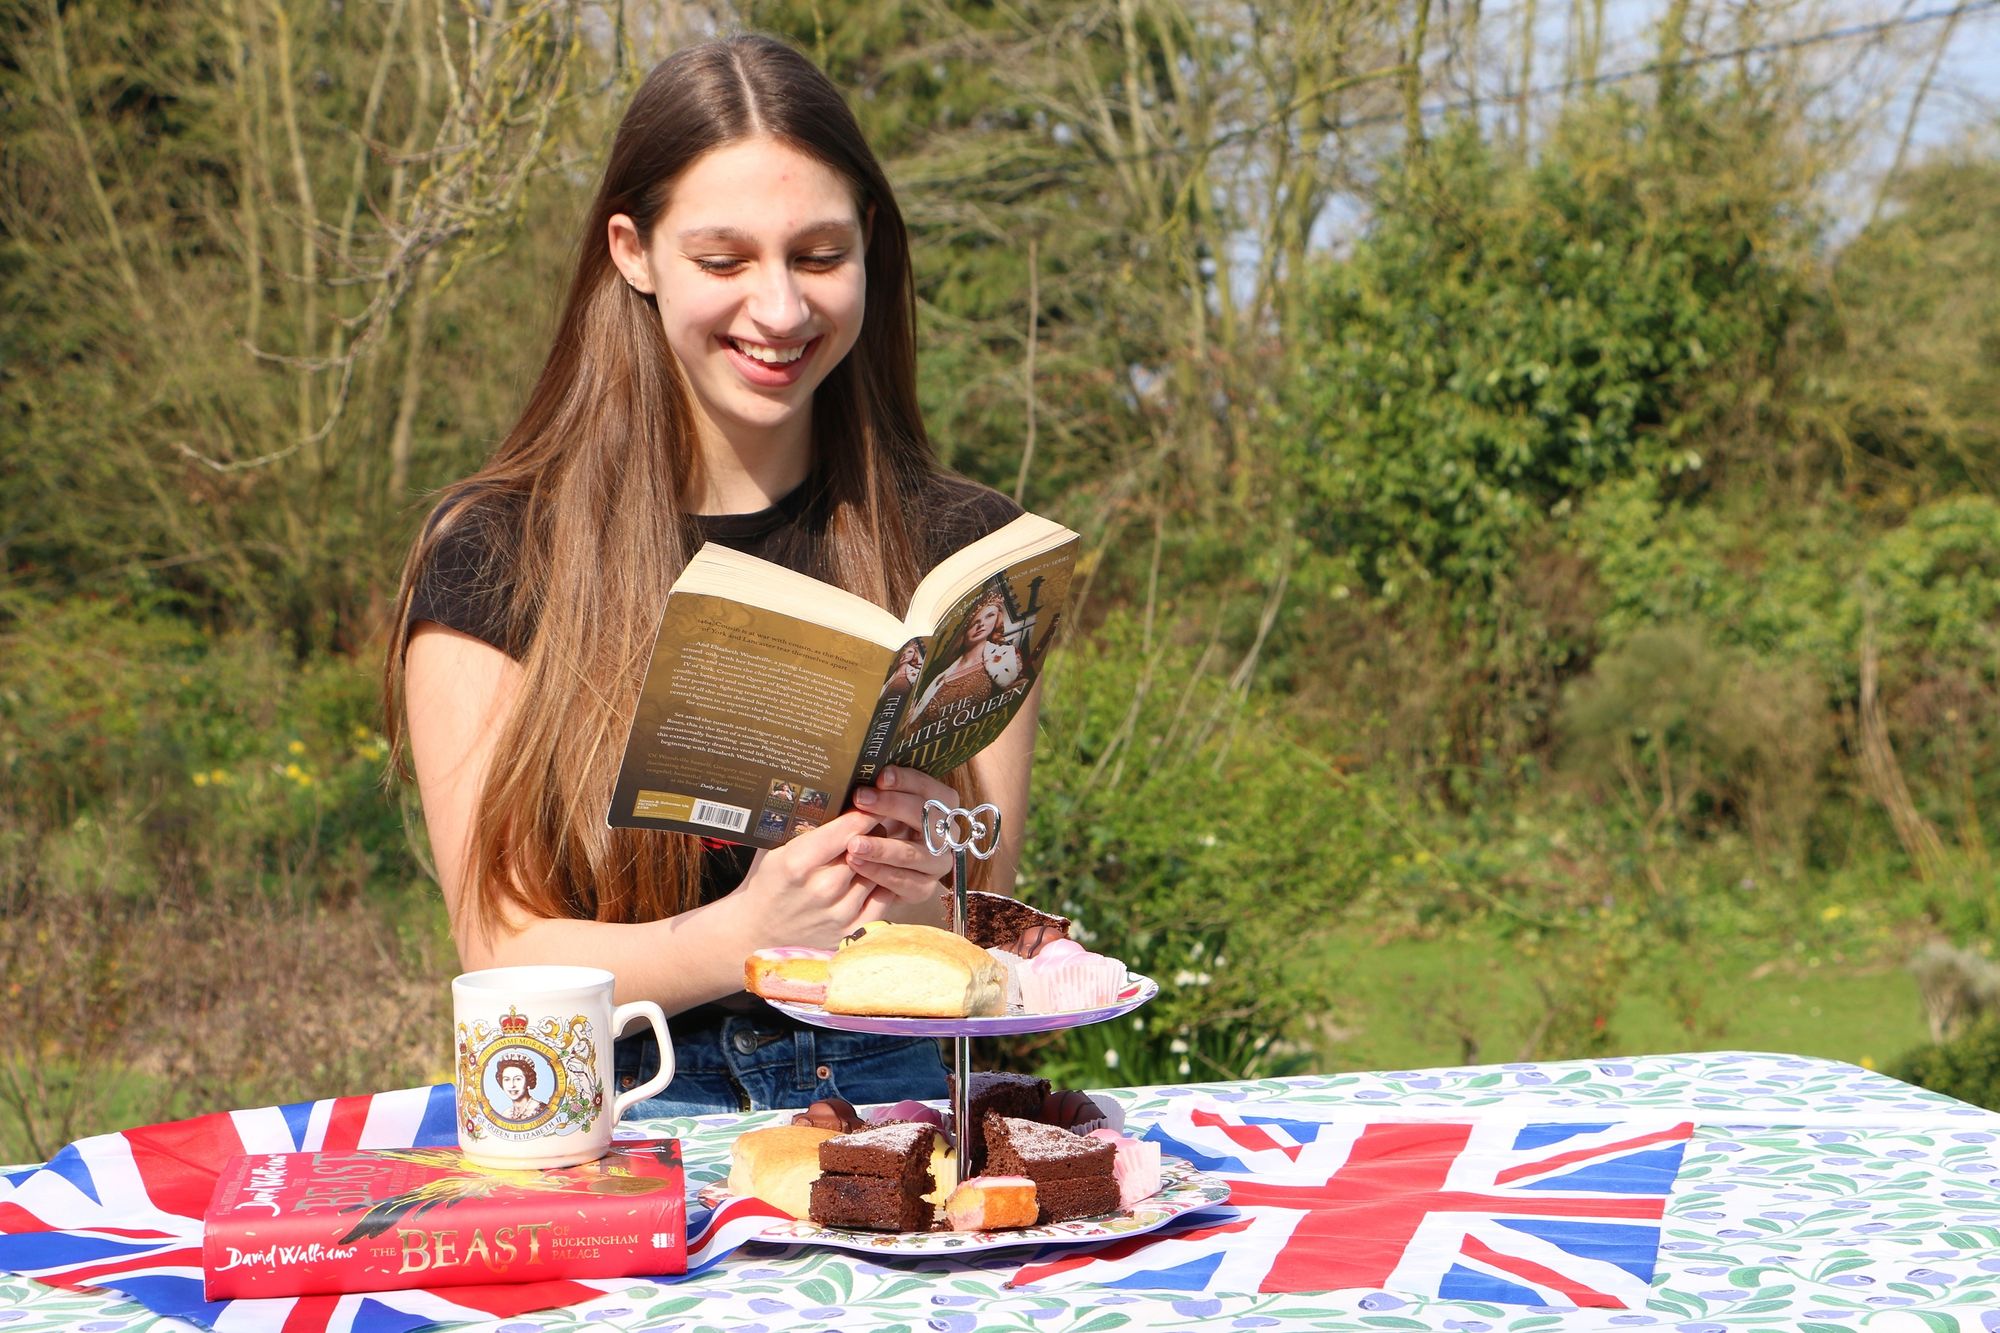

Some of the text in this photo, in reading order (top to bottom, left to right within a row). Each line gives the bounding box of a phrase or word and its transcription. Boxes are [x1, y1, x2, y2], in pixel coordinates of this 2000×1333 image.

[881, 695, 900, 718] THE
[940, 695, 974, 718] THE
[952, 682, 1029, 728] QUEEN
[865, 721, 891, 758] WHITE
[491, 1038, 551, 1054] COMMEMORATE
[476, 1116, 486, 1126] OF
[486, 1123, 510, 1139] QUEEN
[514, 1120, 555, 1140] ELIZABETH
[290, 1153, 392, 1212] BEAST
[214, 1221, 570, 1276] David Walliams THE BEAST OF
[552, 1234, 640, 1248] BUCKINGHAM
[552, 1248, 601, 1260] PALACE
